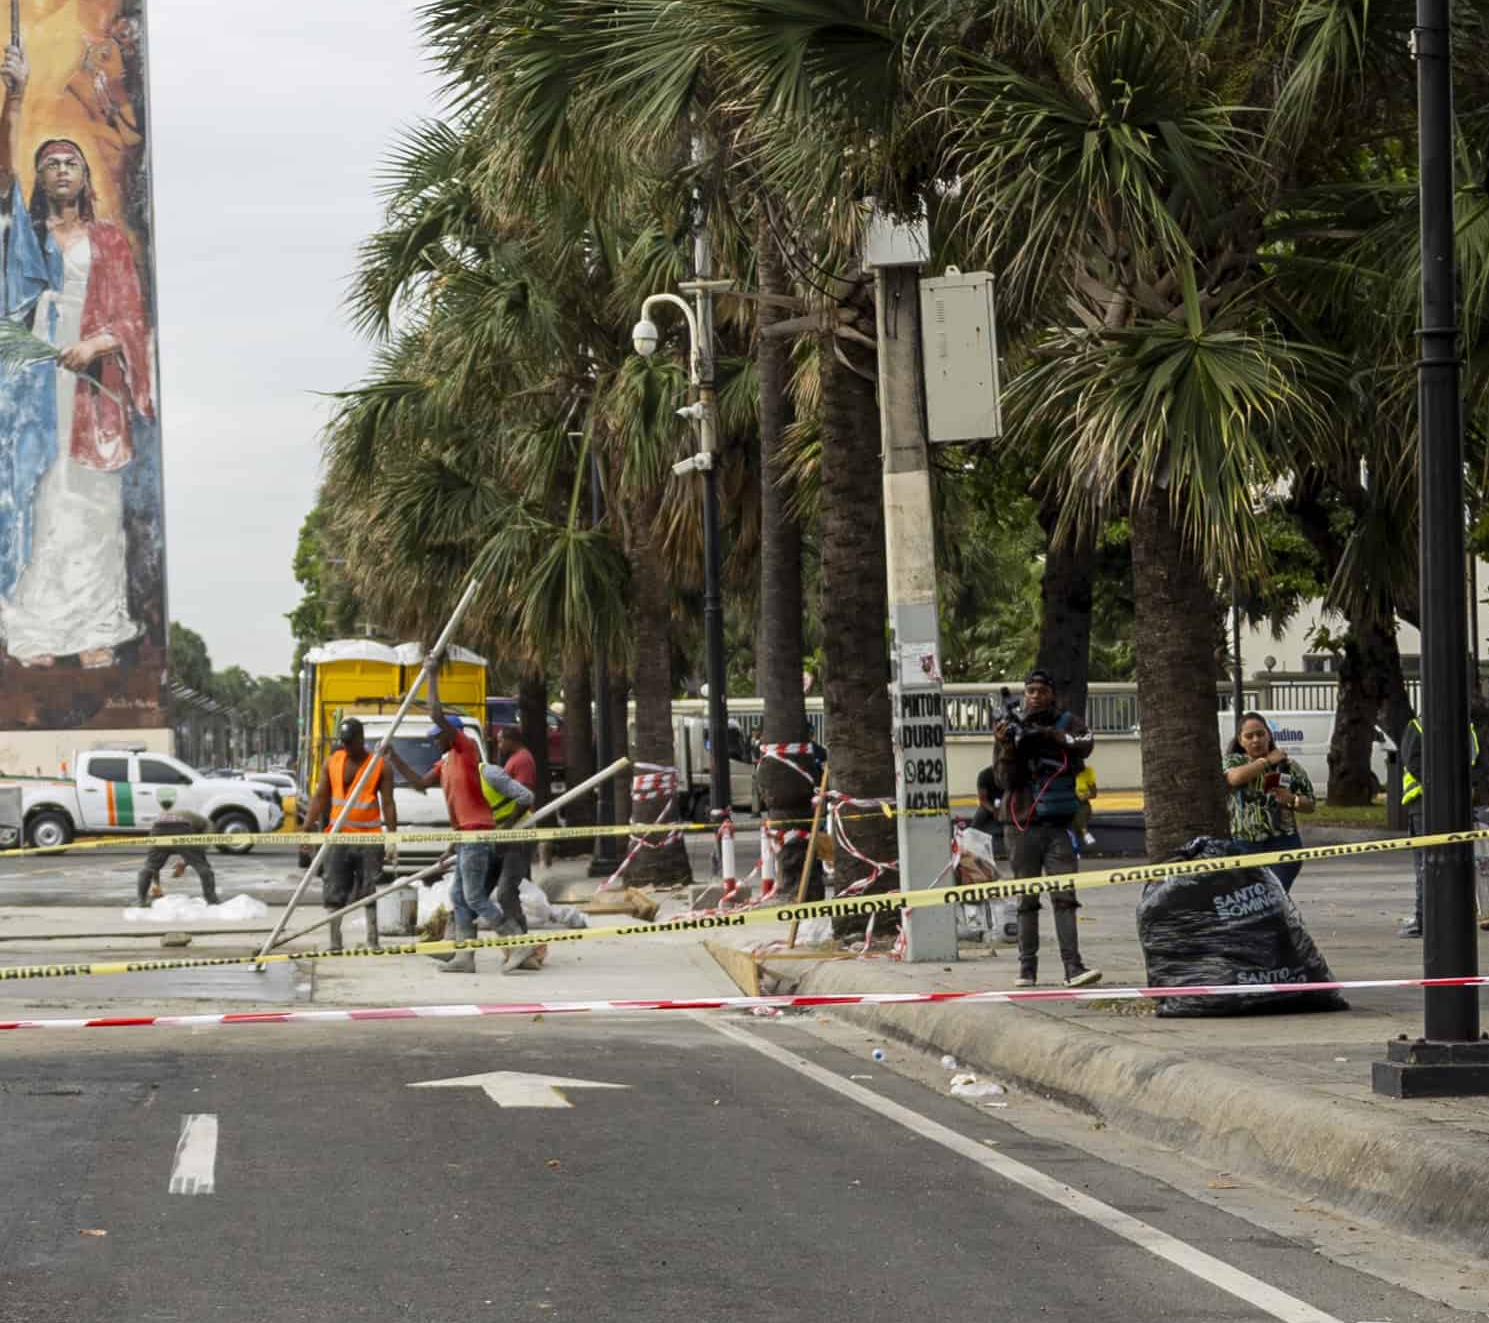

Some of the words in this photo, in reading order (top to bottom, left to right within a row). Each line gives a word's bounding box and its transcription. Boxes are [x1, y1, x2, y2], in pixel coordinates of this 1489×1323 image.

[901, 693, 942, 717] PINTOR
[903, 725, 944, 748] DURO
[1273, 728, 1304, 742] ndino
[917, 759, 943, 784] 829
[1110, 861, 1240, 885] PROHIBIDO
[944, 880, 1075, 905] PROHIBIDO
[1214, 883, 1265, 910] SANTO
[778, 898, 907, 922] PROHIBIDO
[1237, 967, 1289, 983] SANTO
